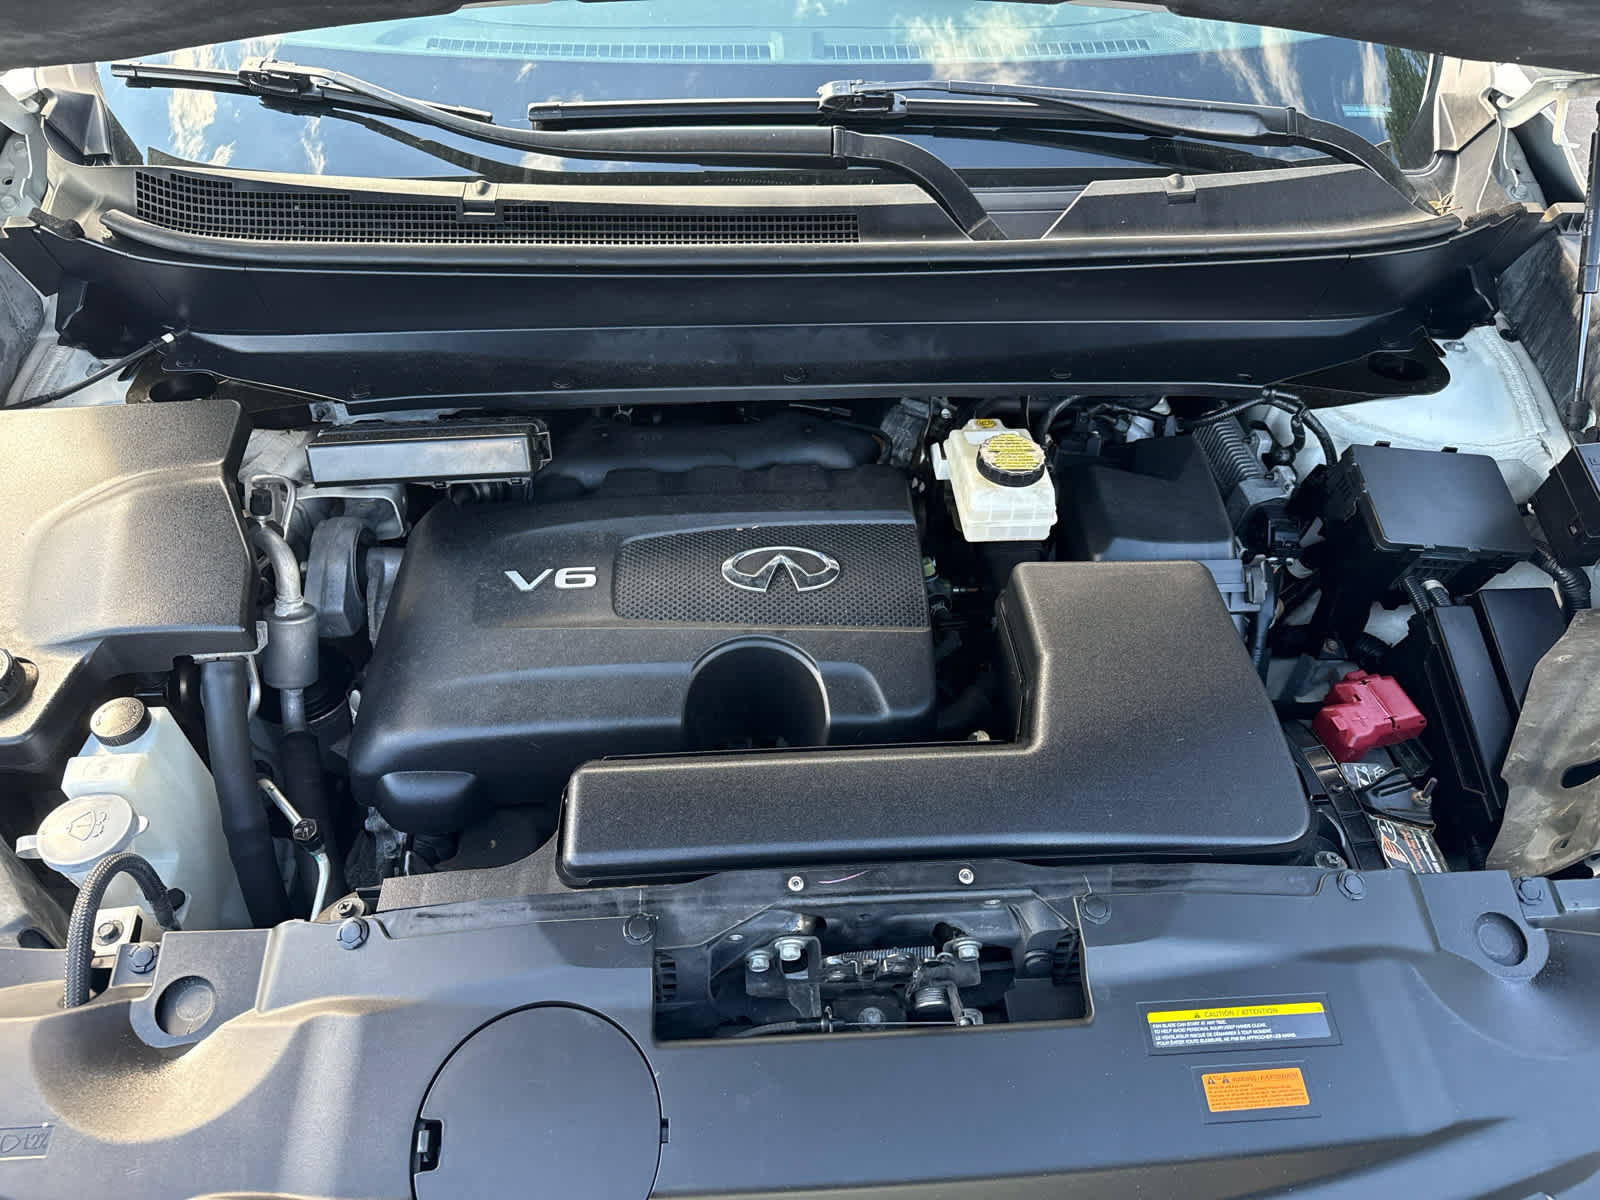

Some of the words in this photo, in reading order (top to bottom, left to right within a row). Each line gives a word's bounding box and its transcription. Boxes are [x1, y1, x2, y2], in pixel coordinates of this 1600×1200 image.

[504, 566, 597, 592] V6
[1204, 1009, 1234, 1018] CAUTION
[1241, 1007, 1279, 1016] ATTENTION
